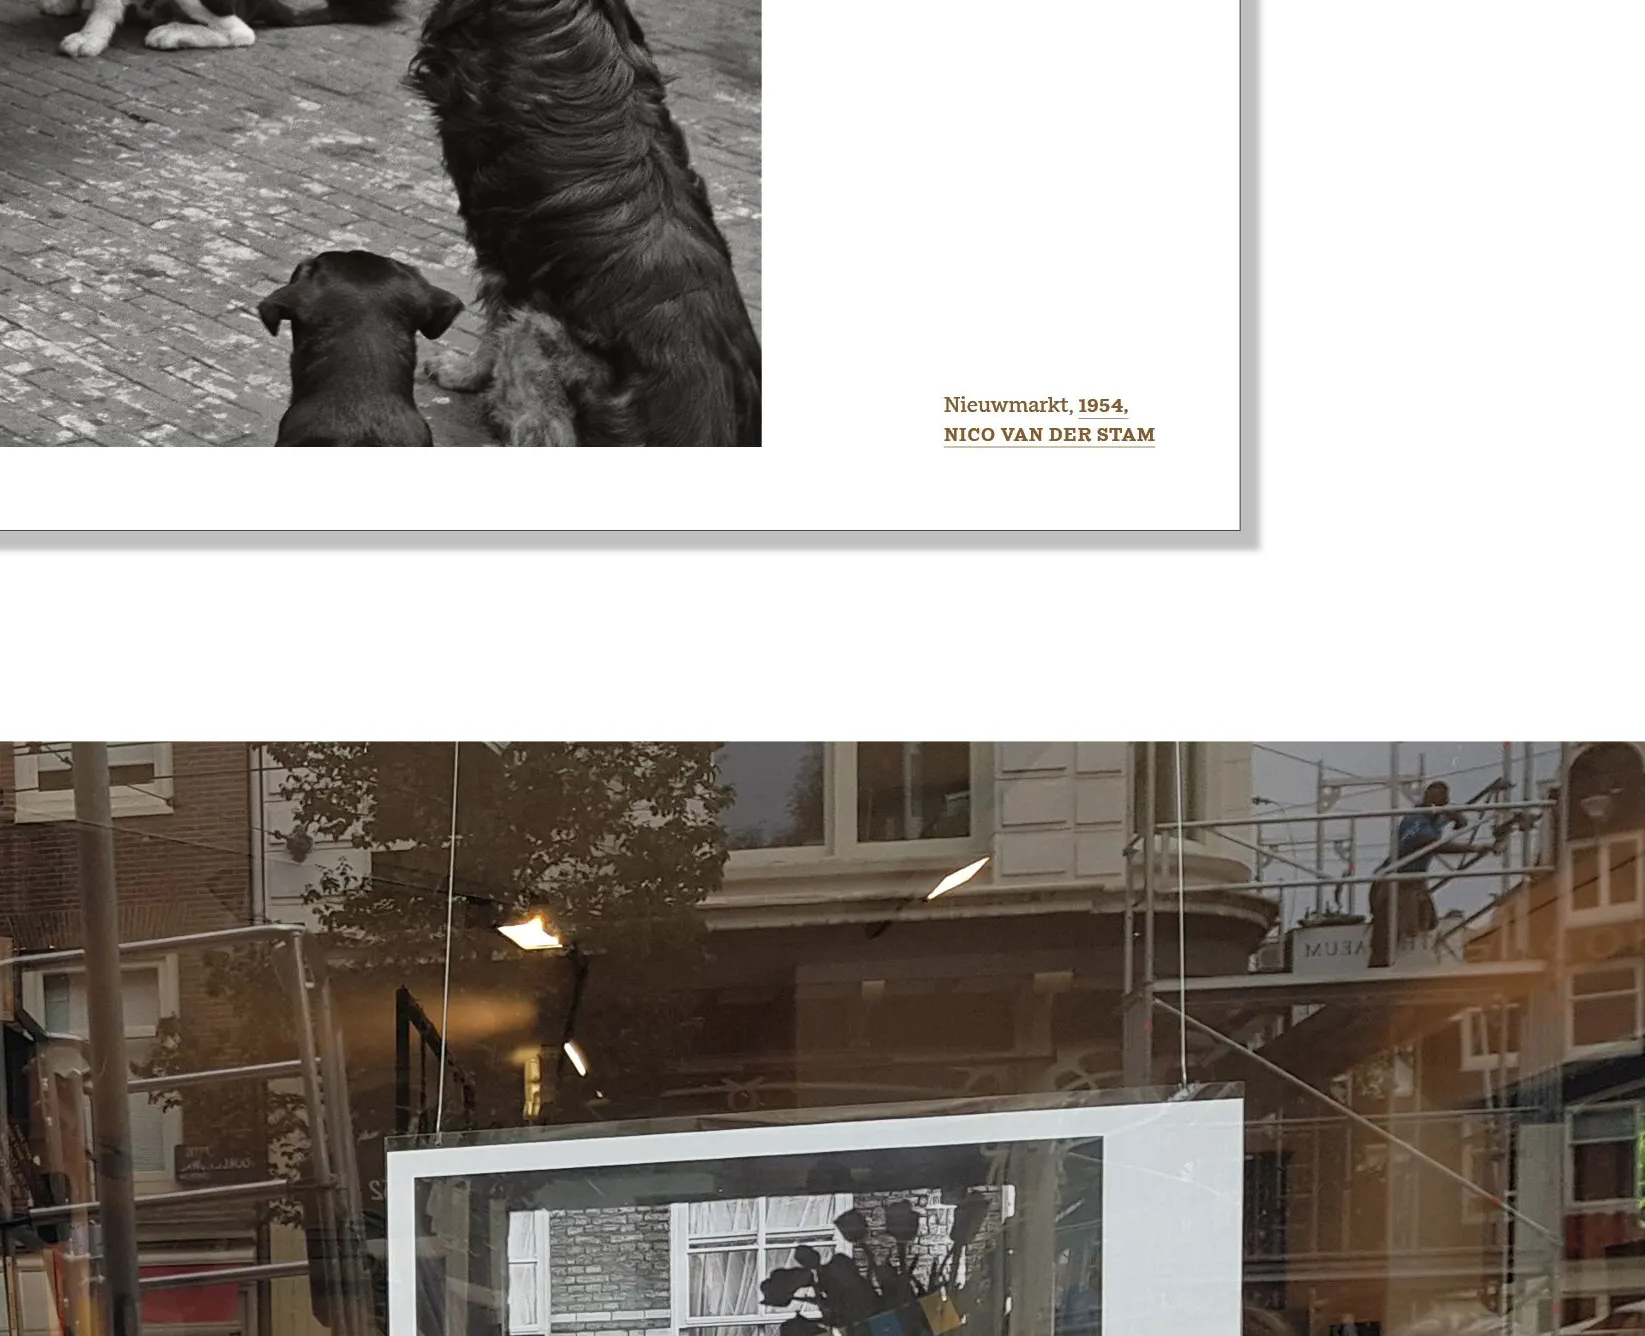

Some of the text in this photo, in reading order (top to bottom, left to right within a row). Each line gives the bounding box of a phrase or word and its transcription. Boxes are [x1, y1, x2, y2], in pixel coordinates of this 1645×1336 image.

[944, 395, 1129, 416] Nieuwmarkt, 1954,
[944, 427, 1155, 443] NICO VAN DER STAM
